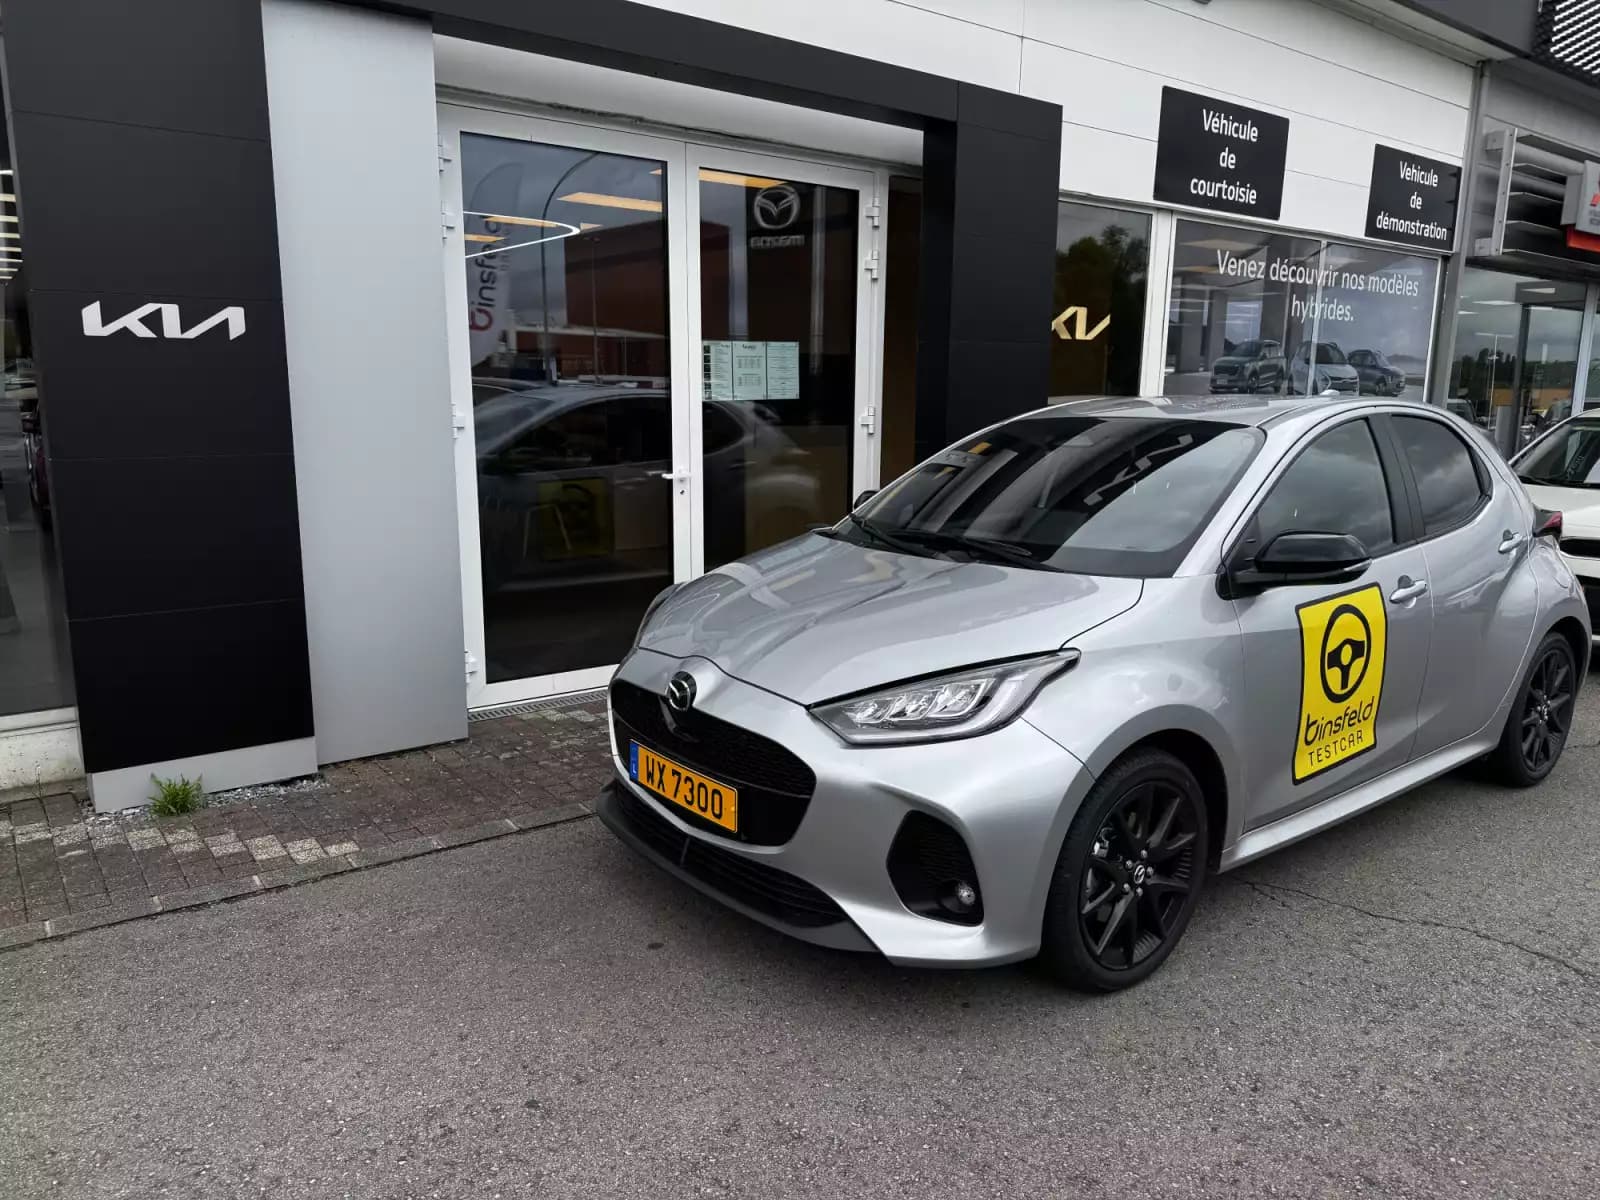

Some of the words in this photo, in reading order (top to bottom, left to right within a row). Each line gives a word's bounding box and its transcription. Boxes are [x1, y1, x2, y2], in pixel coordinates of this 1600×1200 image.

[1203, 109, 1258, 142] Véhicule
[1220, 147, 1236, 169] de
[1400, 161, 1438, 187] Vehicule
[1190, 178, 1257, 204] courtoisie
[1410, 192, 1422, 209] de
[1376, 211, 1447, 240] démonstration
[1217, 249, 1265, 279] Venez
[1269, 258, 1338, 287] découvrir
[1341, 272, 1364, 291] nos
[1367, 273, 1419, 297] modèles
[81, 300, 246, 341] KIA
[1291, 294, 1354, 323] hybrides.
[1304, 696, 1374, 746] binsfeld
[1307, 729, 1364, 767] TESTCAR
[645, 754, 667, 793] WX
[671, 769, 724, 820] 7300
